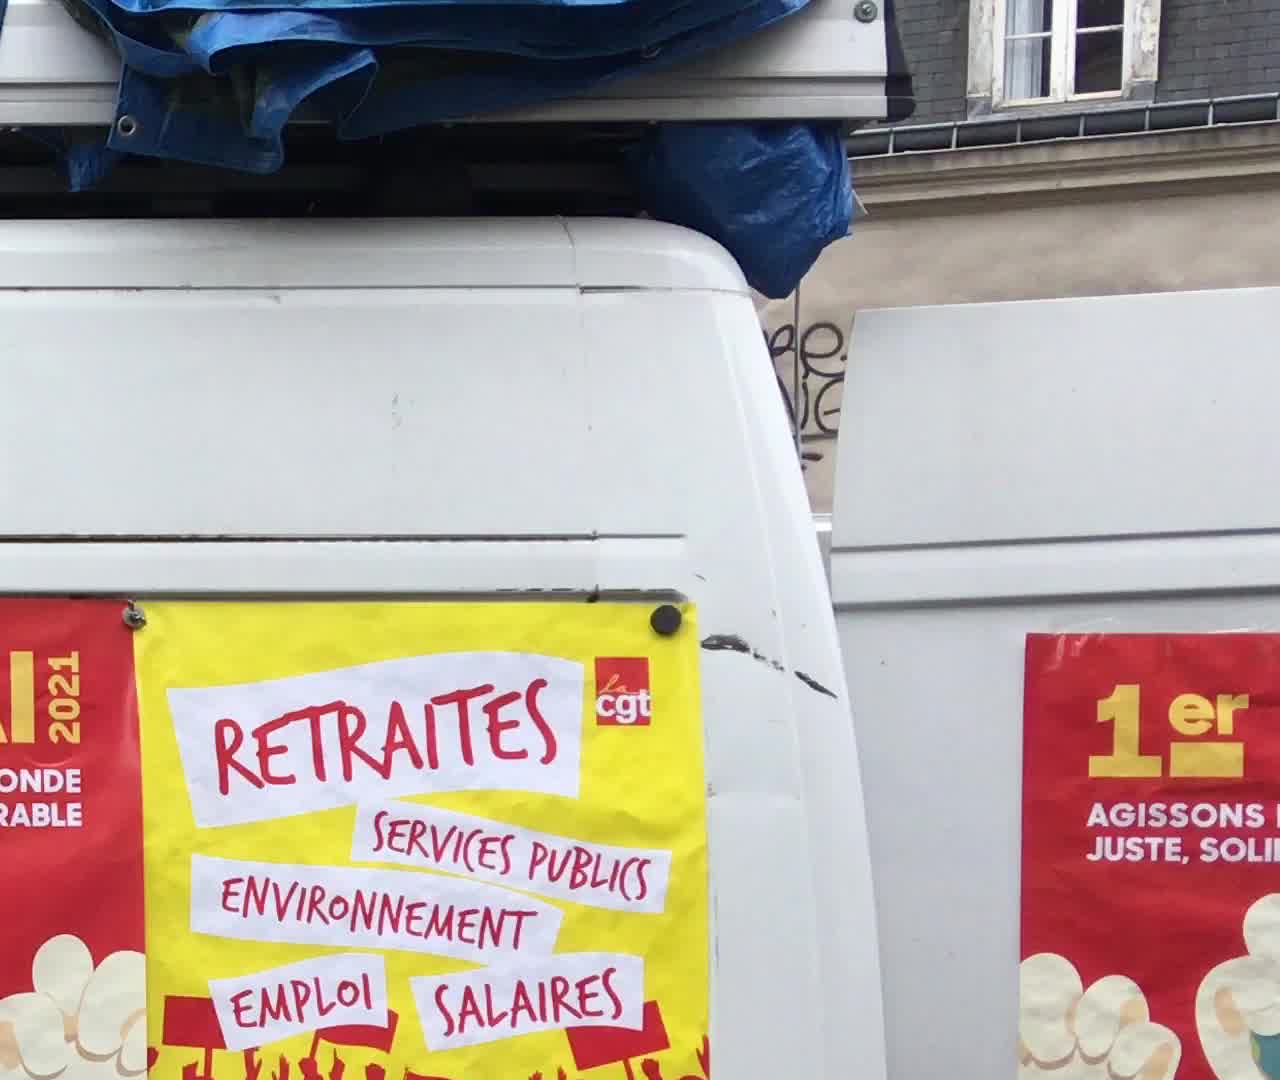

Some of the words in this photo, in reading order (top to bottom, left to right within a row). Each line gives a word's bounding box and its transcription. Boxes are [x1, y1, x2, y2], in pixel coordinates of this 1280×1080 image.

[48, 651, 81, 744] 2021
[596, 689, 651, 724] cgt
[1088, 684, 1249, 777] 1er
[214, 678, 558, 795] RETRAITES
[1086, 802, 1265, 828] AGISSONS
[1086, 836, 1189, 864] JUSTE,
[372, 811, 514, 875] SERVICES
[528, 842, 652, 902] PUBLICS
[221, 875, 538, 950] ENVIRONNEMENT
[230, 973, 373, 1029] EMPLOI
[434, 968, 623, 1037] SALAIRES
